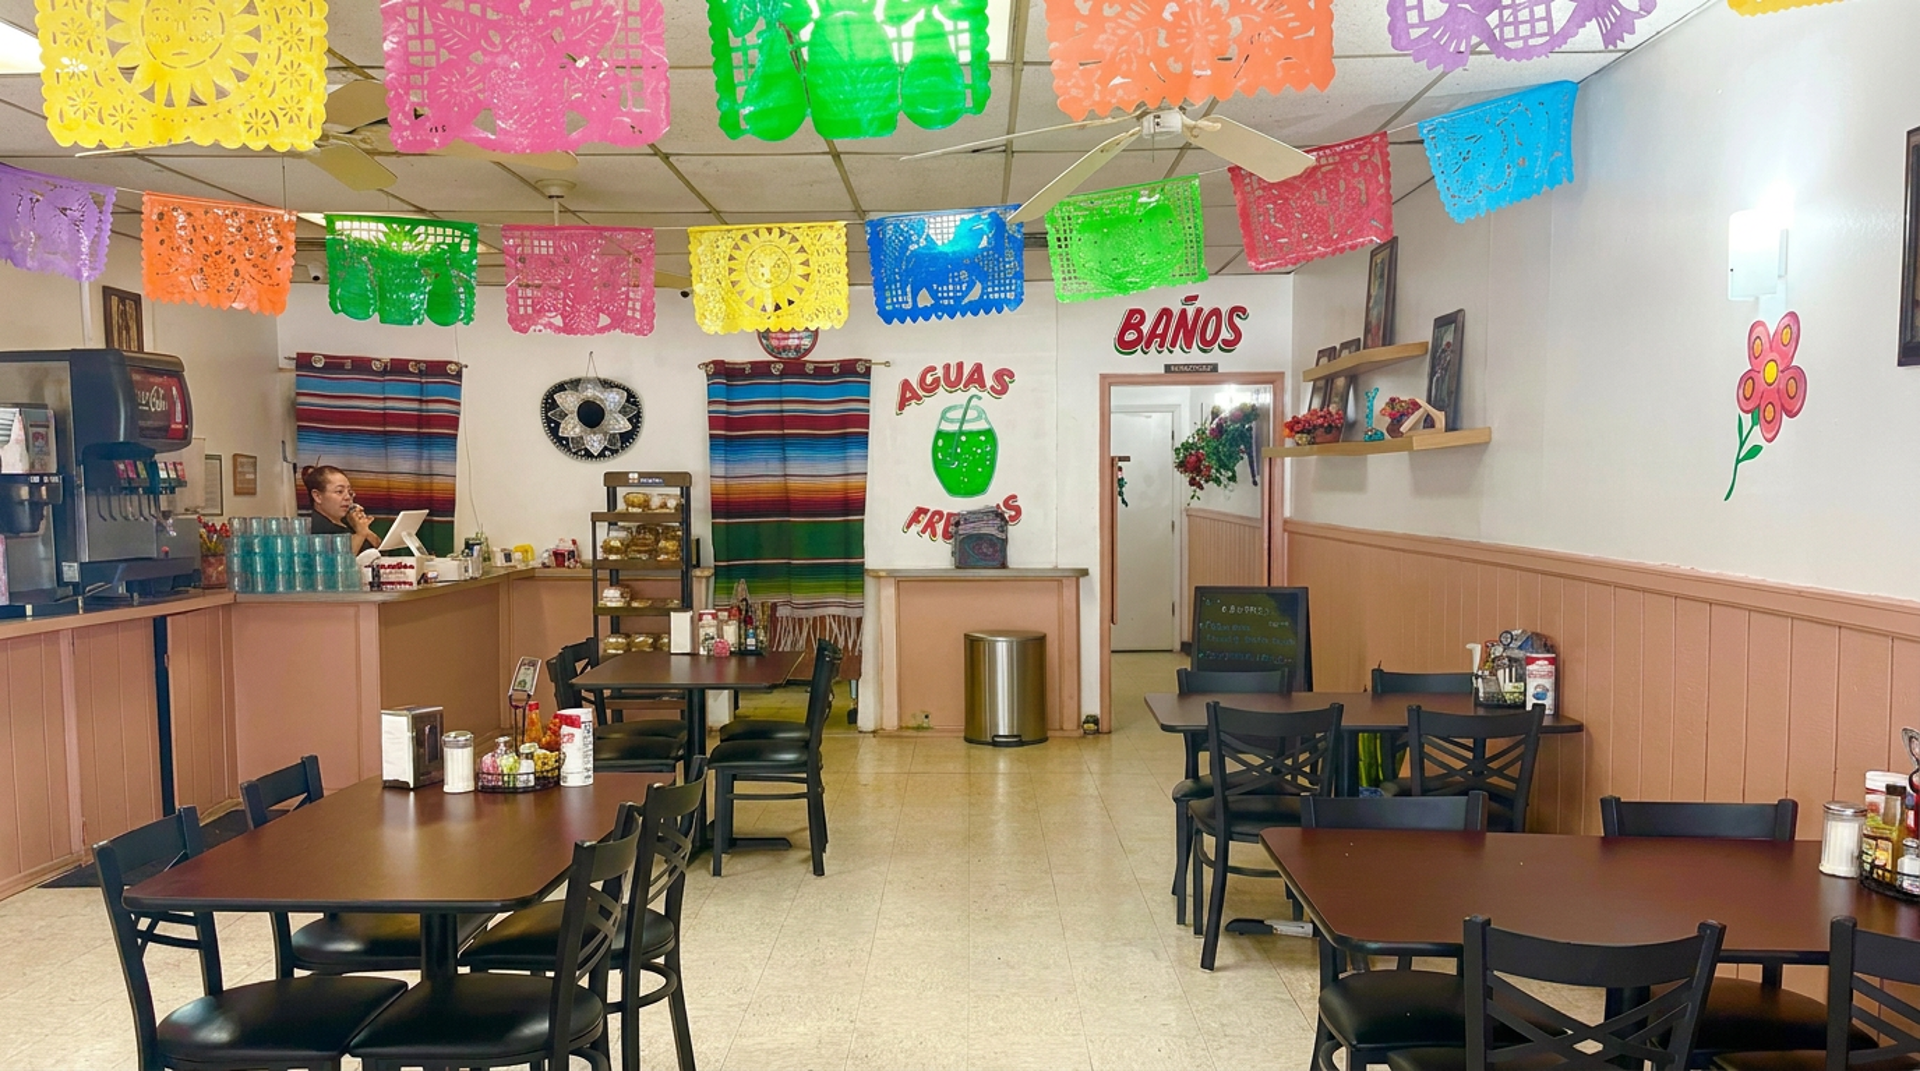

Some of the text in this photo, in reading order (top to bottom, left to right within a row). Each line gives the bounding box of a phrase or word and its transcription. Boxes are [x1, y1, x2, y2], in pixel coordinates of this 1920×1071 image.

[1114, 294, 1249, 356] BAÑOS
[896, 361, 1016, 415] AGUAS
[902, 494, 1023, 544] FRES
